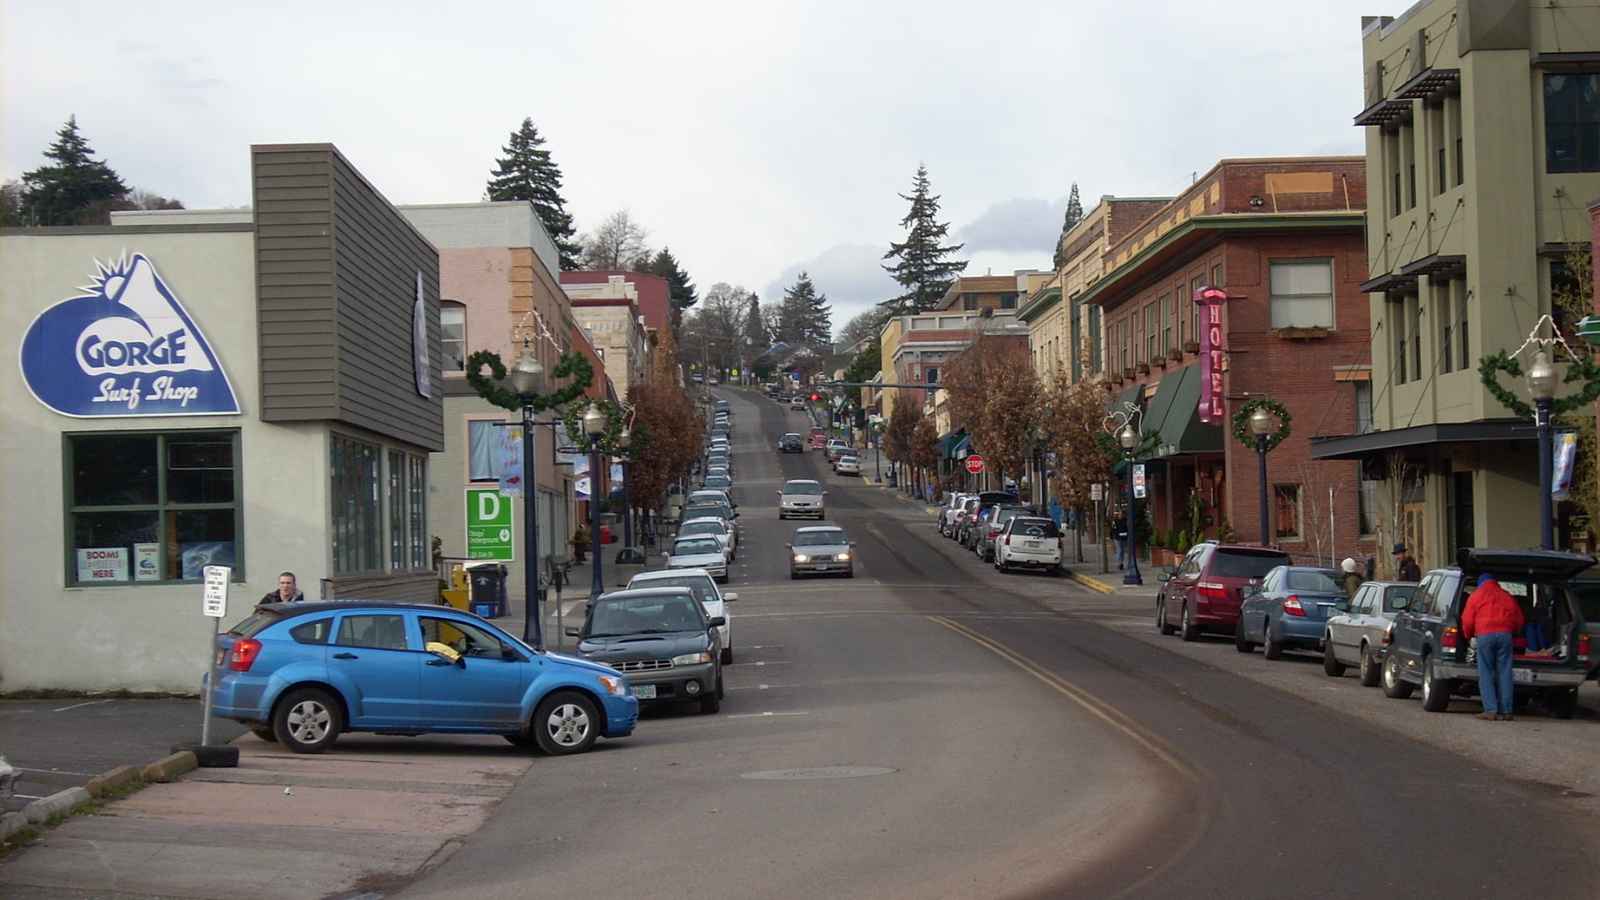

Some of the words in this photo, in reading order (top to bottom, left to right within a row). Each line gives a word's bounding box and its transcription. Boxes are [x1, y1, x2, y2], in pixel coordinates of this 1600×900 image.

[81, 328, 186, 368] GORGE
[1208, 304, 1223, 416] HOTEL
[92, 378, 142, 410] Surf
[145, 375, 199, 408] Shop
[966, 460, 983, 468] STOP
[479, 492, 500, 521] D
[92, 569, 113, 578] HERE
